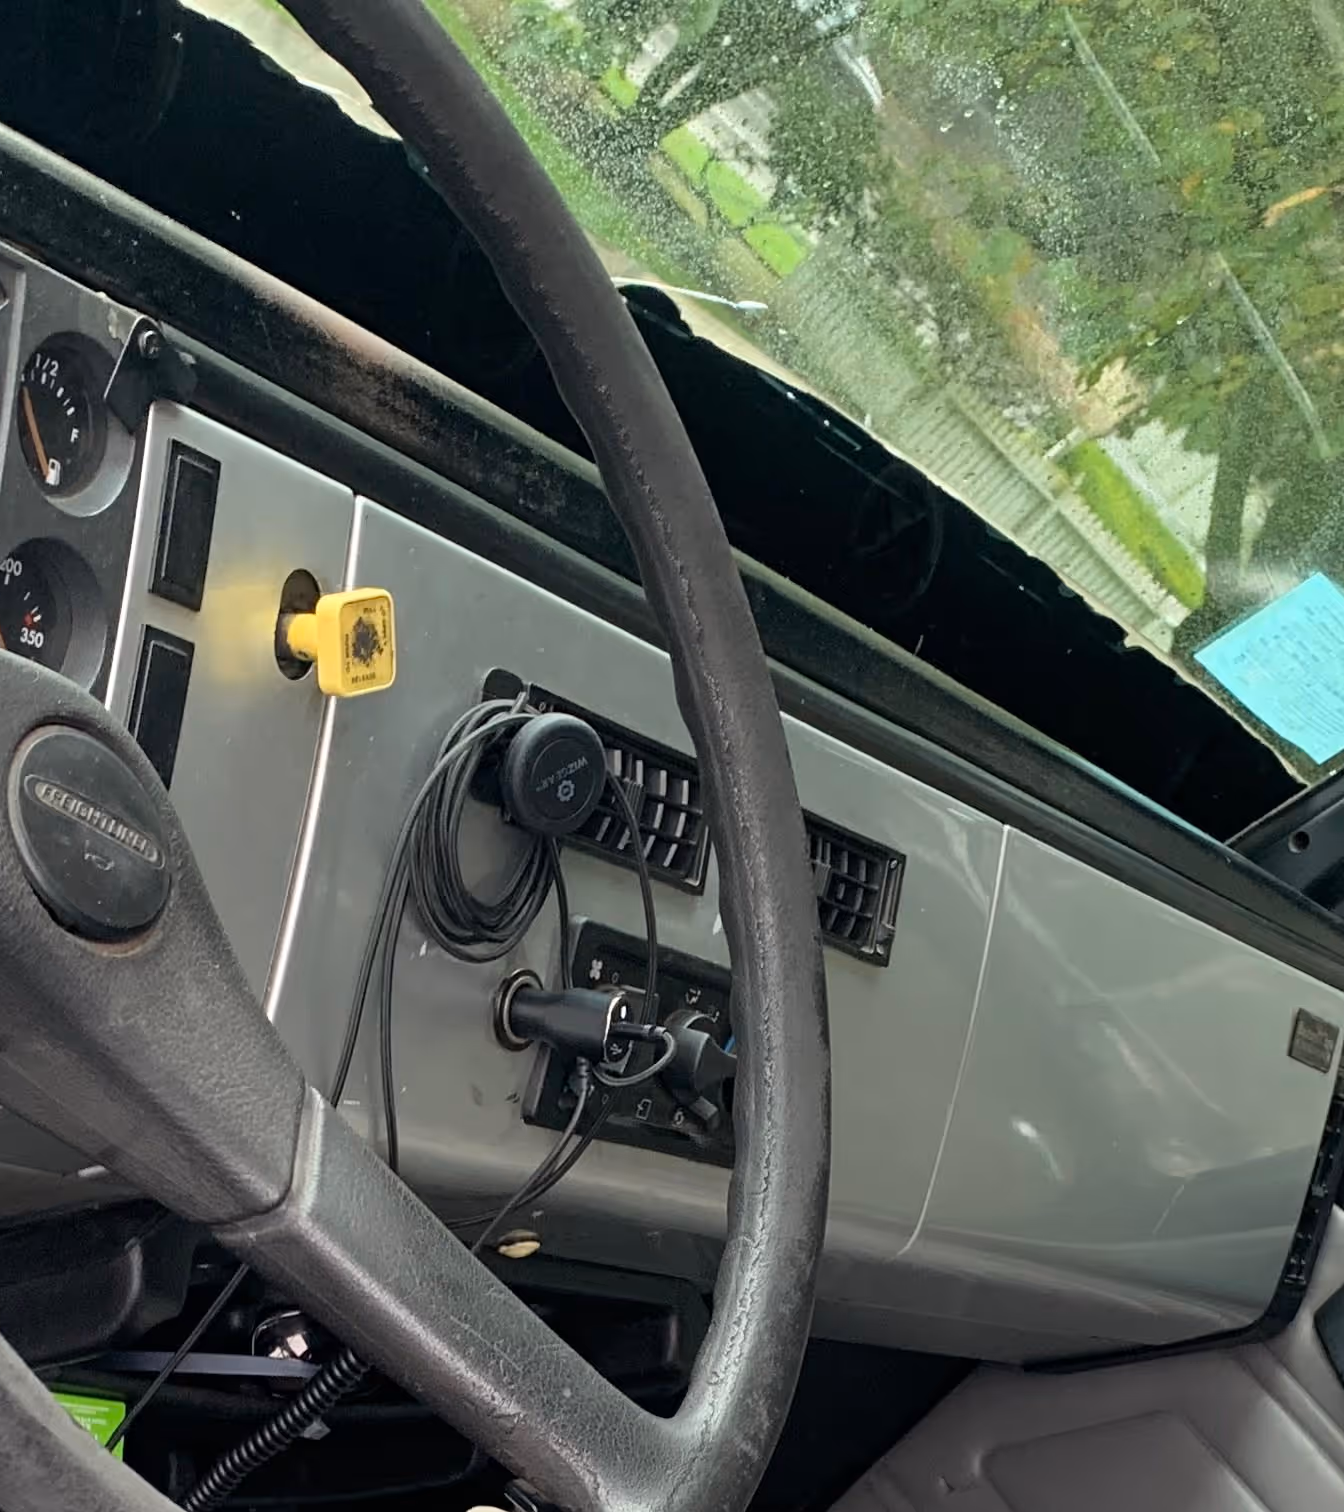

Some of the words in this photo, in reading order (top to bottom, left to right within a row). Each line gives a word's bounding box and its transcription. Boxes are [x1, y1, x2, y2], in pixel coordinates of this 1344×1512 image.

[34, 352, 60, 377] 1/2
[69, 428, 80, 444] F
[19, 627, 45, 649] 350
